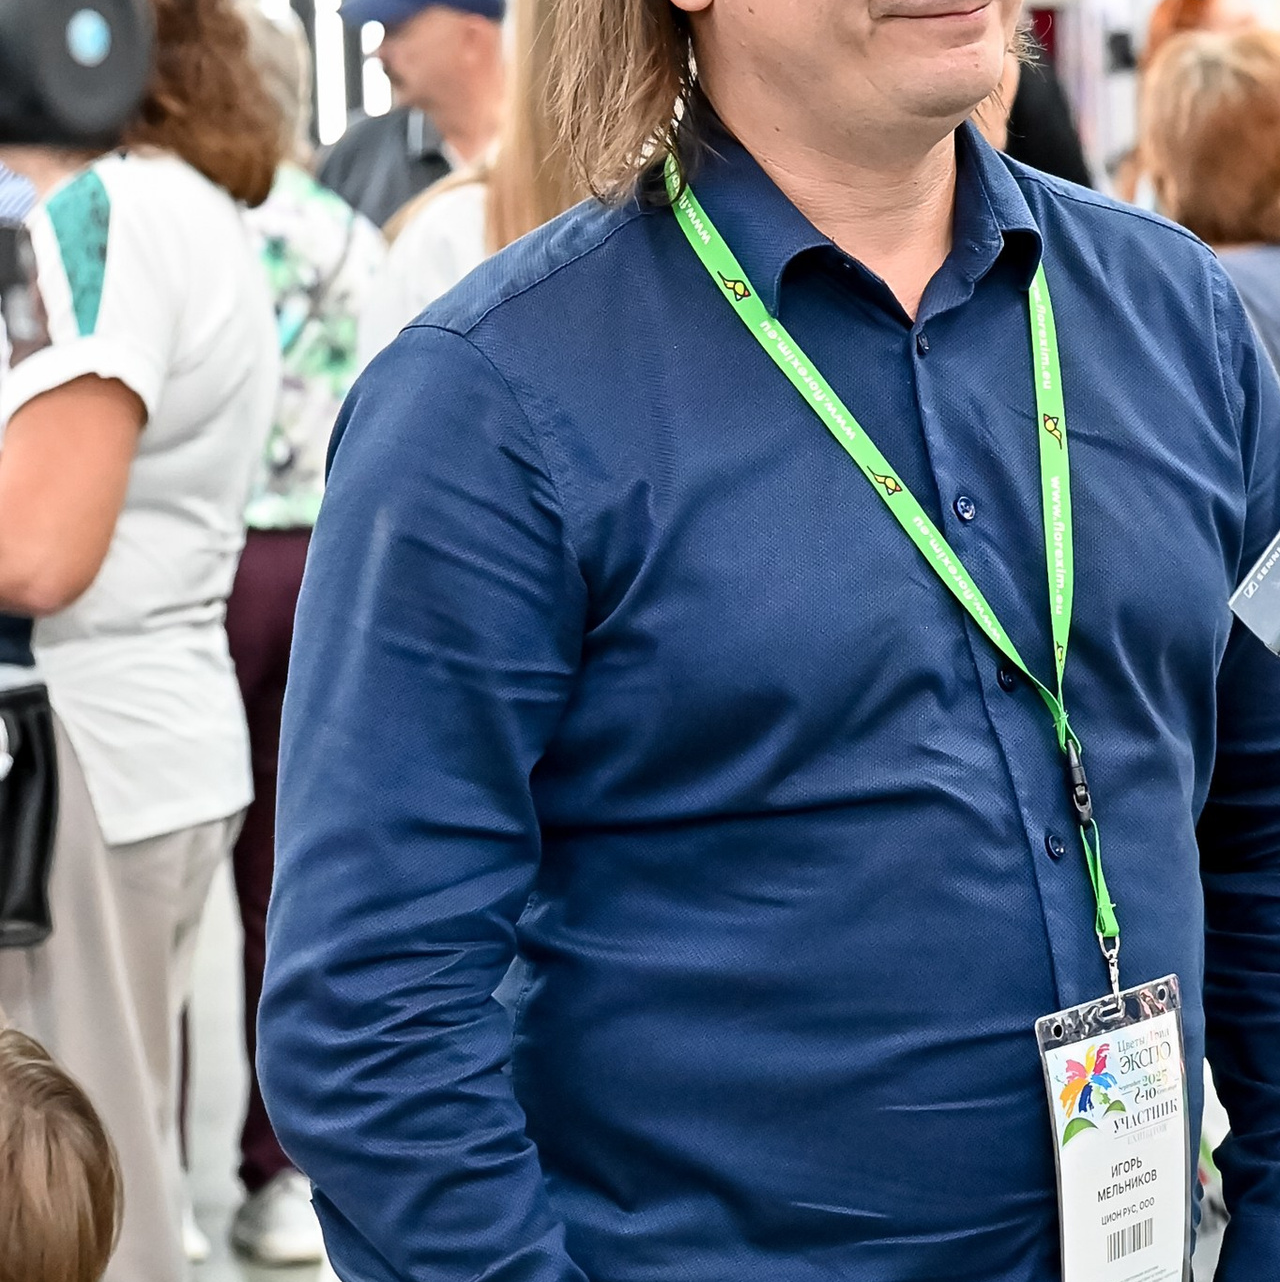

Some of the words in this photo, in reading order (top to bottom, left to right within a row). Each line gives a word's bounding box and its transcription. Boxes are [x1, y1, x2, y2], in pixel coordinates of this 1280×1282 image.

[760, 320, 857, 440] www.florexim.eu
[1050, 476, 1067, 615] www.florexim.eu
[912, 516, 1001, 641] www.florexim.eu
[1119, 1041, 1171, 1075] ЭКСПО
[1142, 1069, 1169, 1087] 2025
[1113, 1098, 1178, 1133] УЧАСТНИК
[1111, 1156, 1143, 1178] ИГОРЬ
[1097, 1169, 1158, 1202] МЕЛЬНИКОВ
[1101, 1209, 1122, 1225] ЦИОН
[1122, 1204, 1138, 1217] РУС,
[1139, 1197, 1155, 1211] ООО
